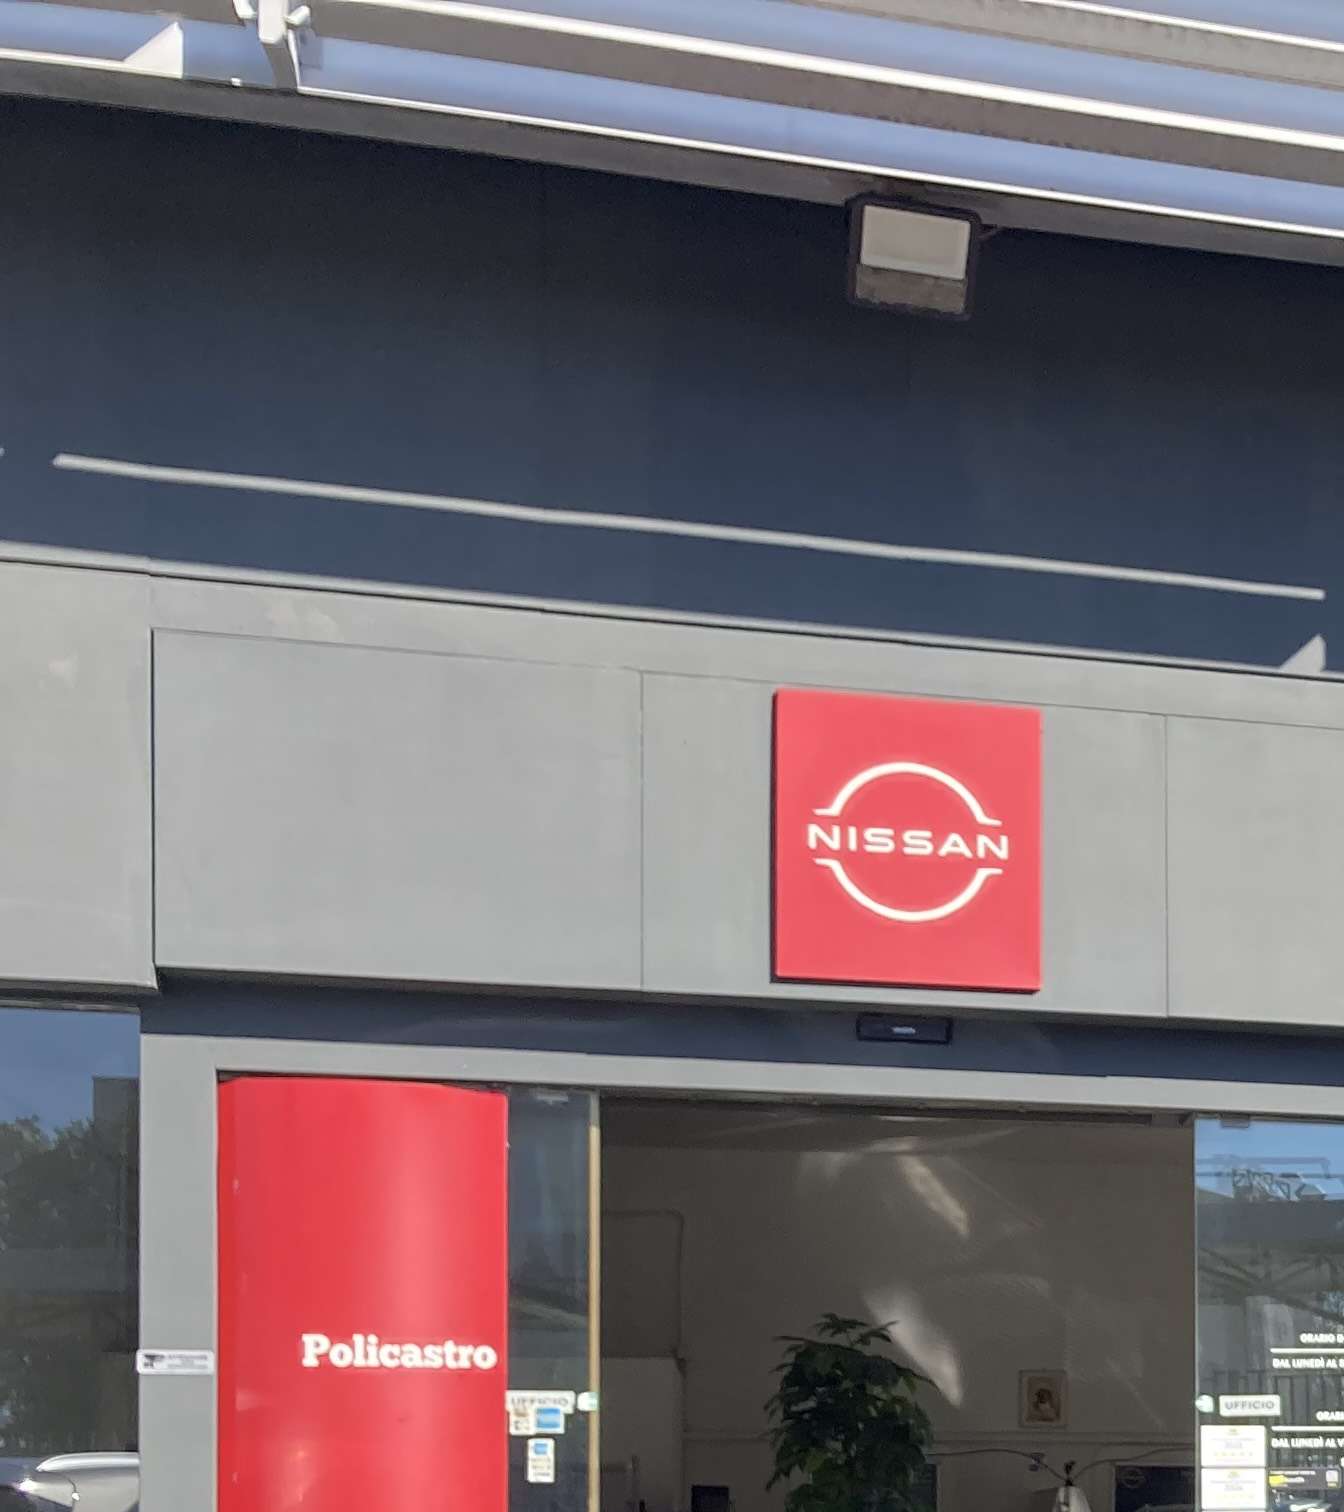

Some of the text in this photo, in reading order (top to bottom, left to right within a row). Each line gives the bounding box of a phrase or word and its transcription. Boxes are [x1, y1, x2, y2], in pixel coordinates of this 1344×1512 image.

[806, 823, 1009, 860] NISSAN
[1299, 1333, 1336, 1344] ORARIO
[301, 1333, 498, 1370] Policastro
[1272, 1358, 1291, 1369] DAL
[1325, 1358, 1338, 1369] AL
[1224, 1400, 1275, 1410] UFFICIO
[1316, 1411, 1344, 1421] ORARI
[1271, 1438, 1290, 1448] DAL
[1325, 1438, 1337, 1448] AL
